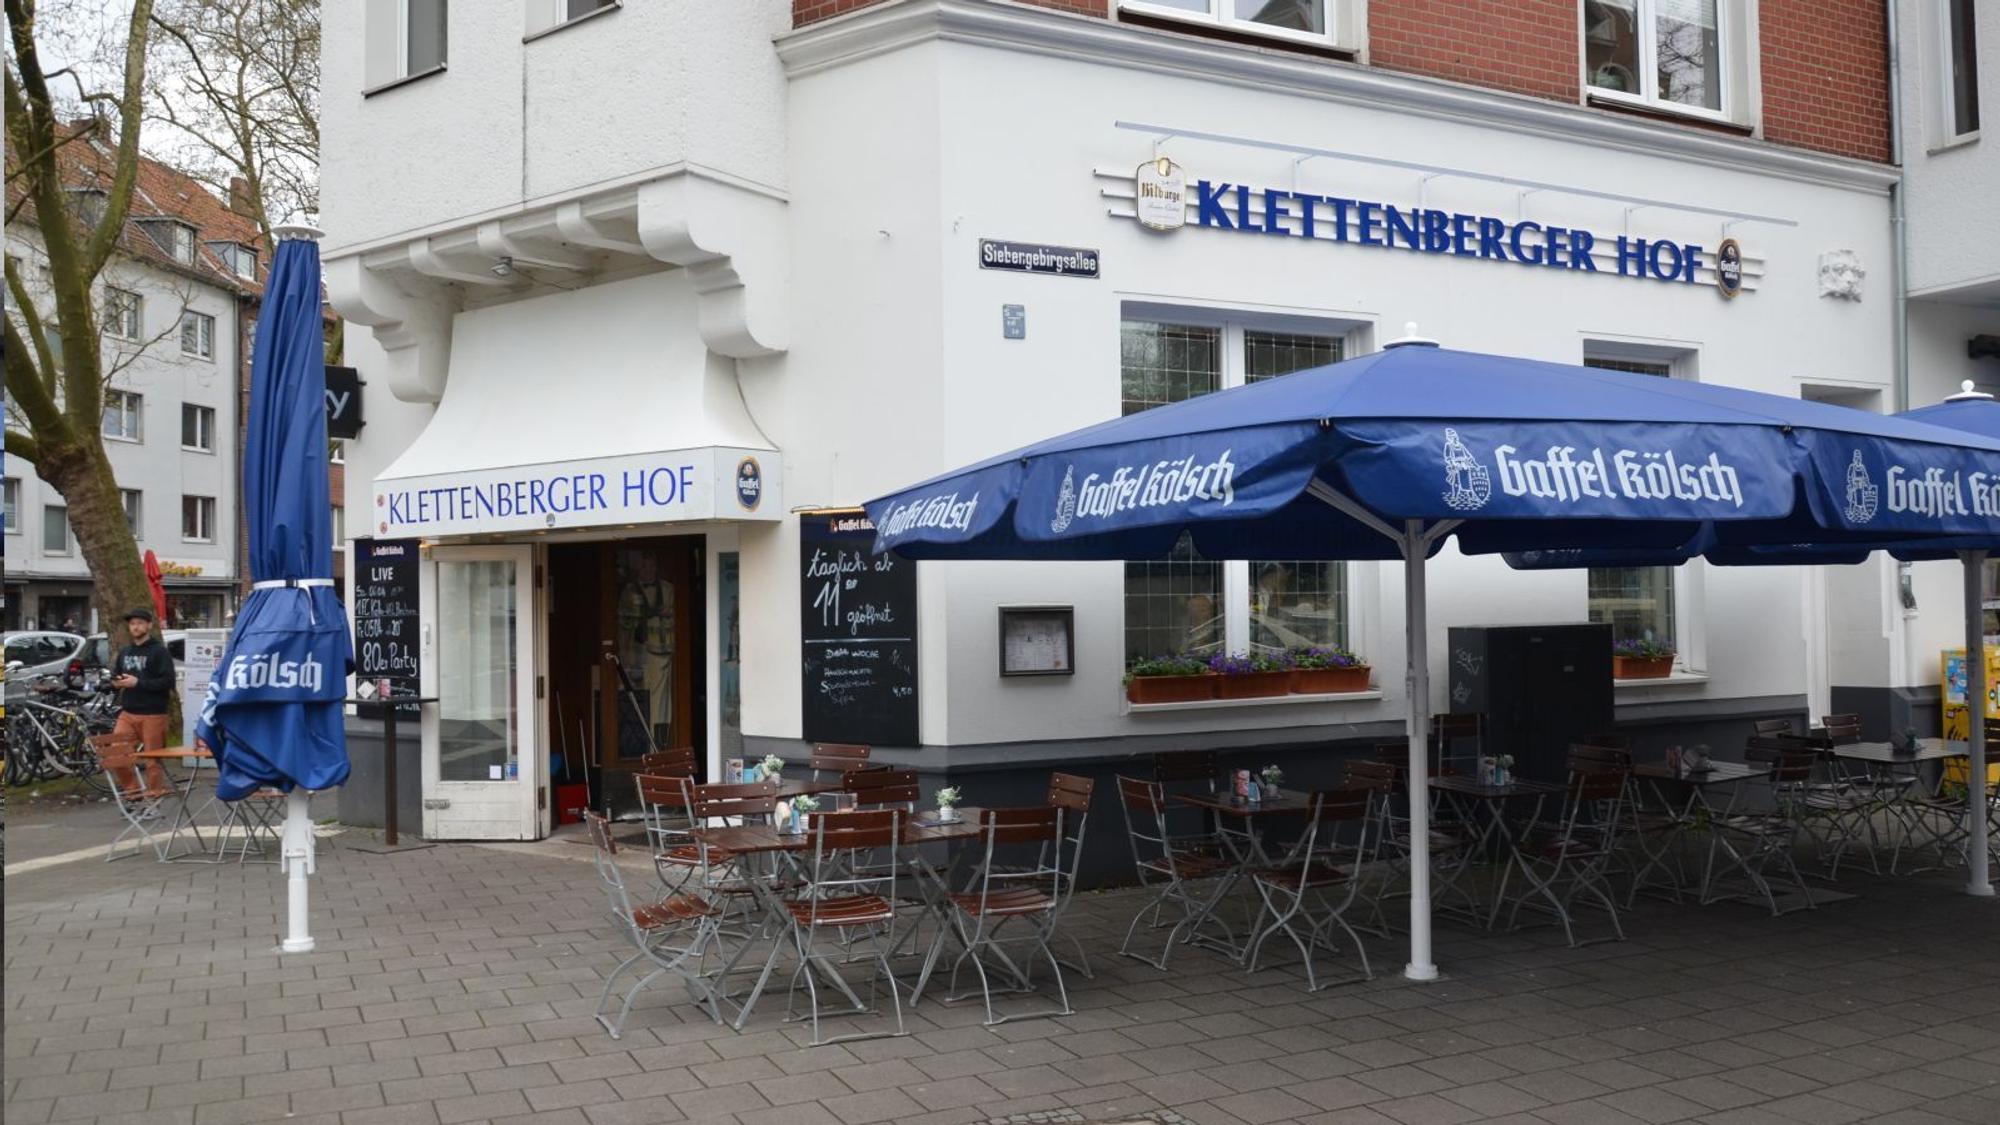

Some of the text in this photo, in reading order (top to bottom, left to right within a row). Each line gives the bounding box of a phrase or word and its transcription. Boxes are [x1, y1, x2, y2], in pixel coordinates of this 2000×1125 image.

[1198, 179, 1703, 284] KLETTENBERGER HOF
[984, 243, 1097, 273] Siebengebirgsallee
[389, 465, 695, 525] KLETTENBERGER HOF
[1076, 448, 1235, 519] Gaffel Kölsch
[1495, 444, 1743, 508] Gaffel Kölsch
[1886, 465, 1969, 519] Gaffel
[916, 491, 980, 533] Kölsch
[371, 567, 394, 581] LIVE
[806, 548, 894, 583] täglich ab
[847, 603, 895, 636] geöffnet
[225, 651, 322, 693] Kölsch
[362, 641, 417, 677] 80er Party
